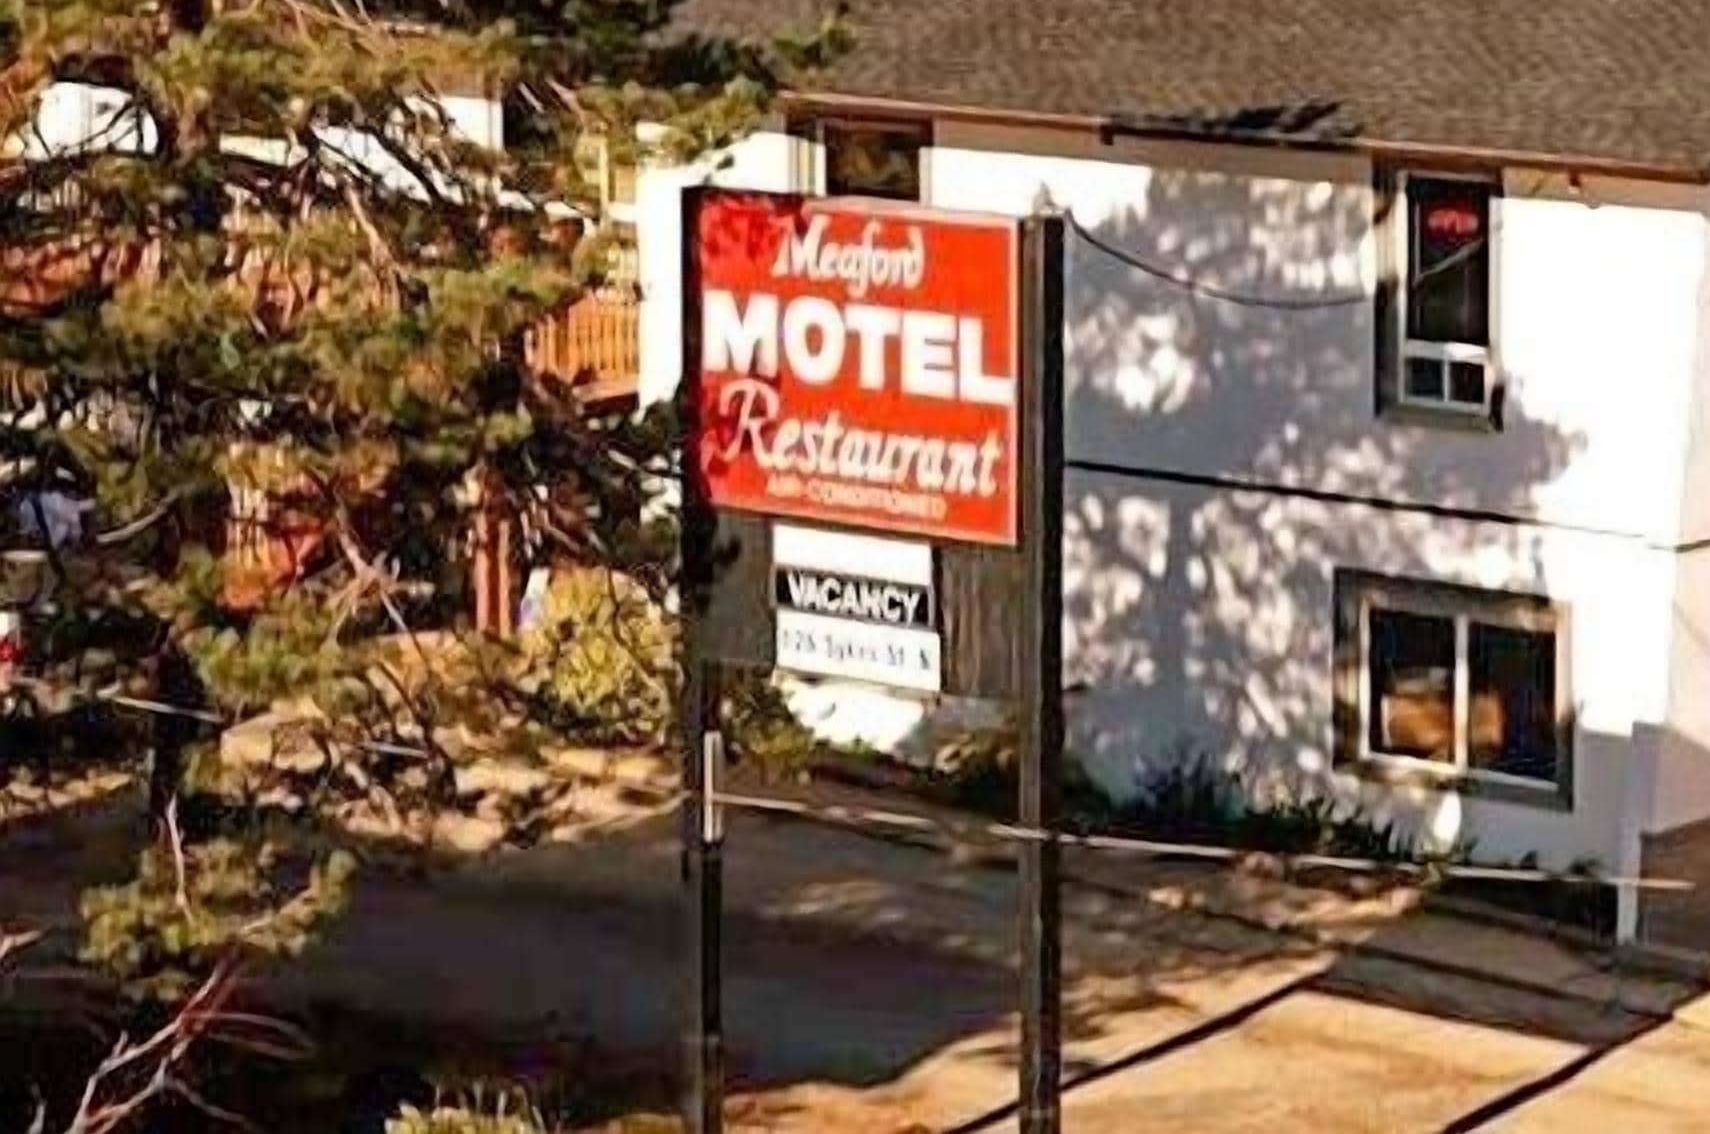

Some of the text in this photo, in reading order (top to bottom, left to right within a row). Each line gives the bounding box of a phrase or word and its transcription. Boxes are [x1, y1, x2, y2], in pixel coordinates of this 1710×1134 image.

[771, 215, 926, 298] Meaford
[702, 290, 1016, 406] MOTEL
[719, 378, 1002, 497] Restaurant
[787, 570, 921, 627] VACANCY
